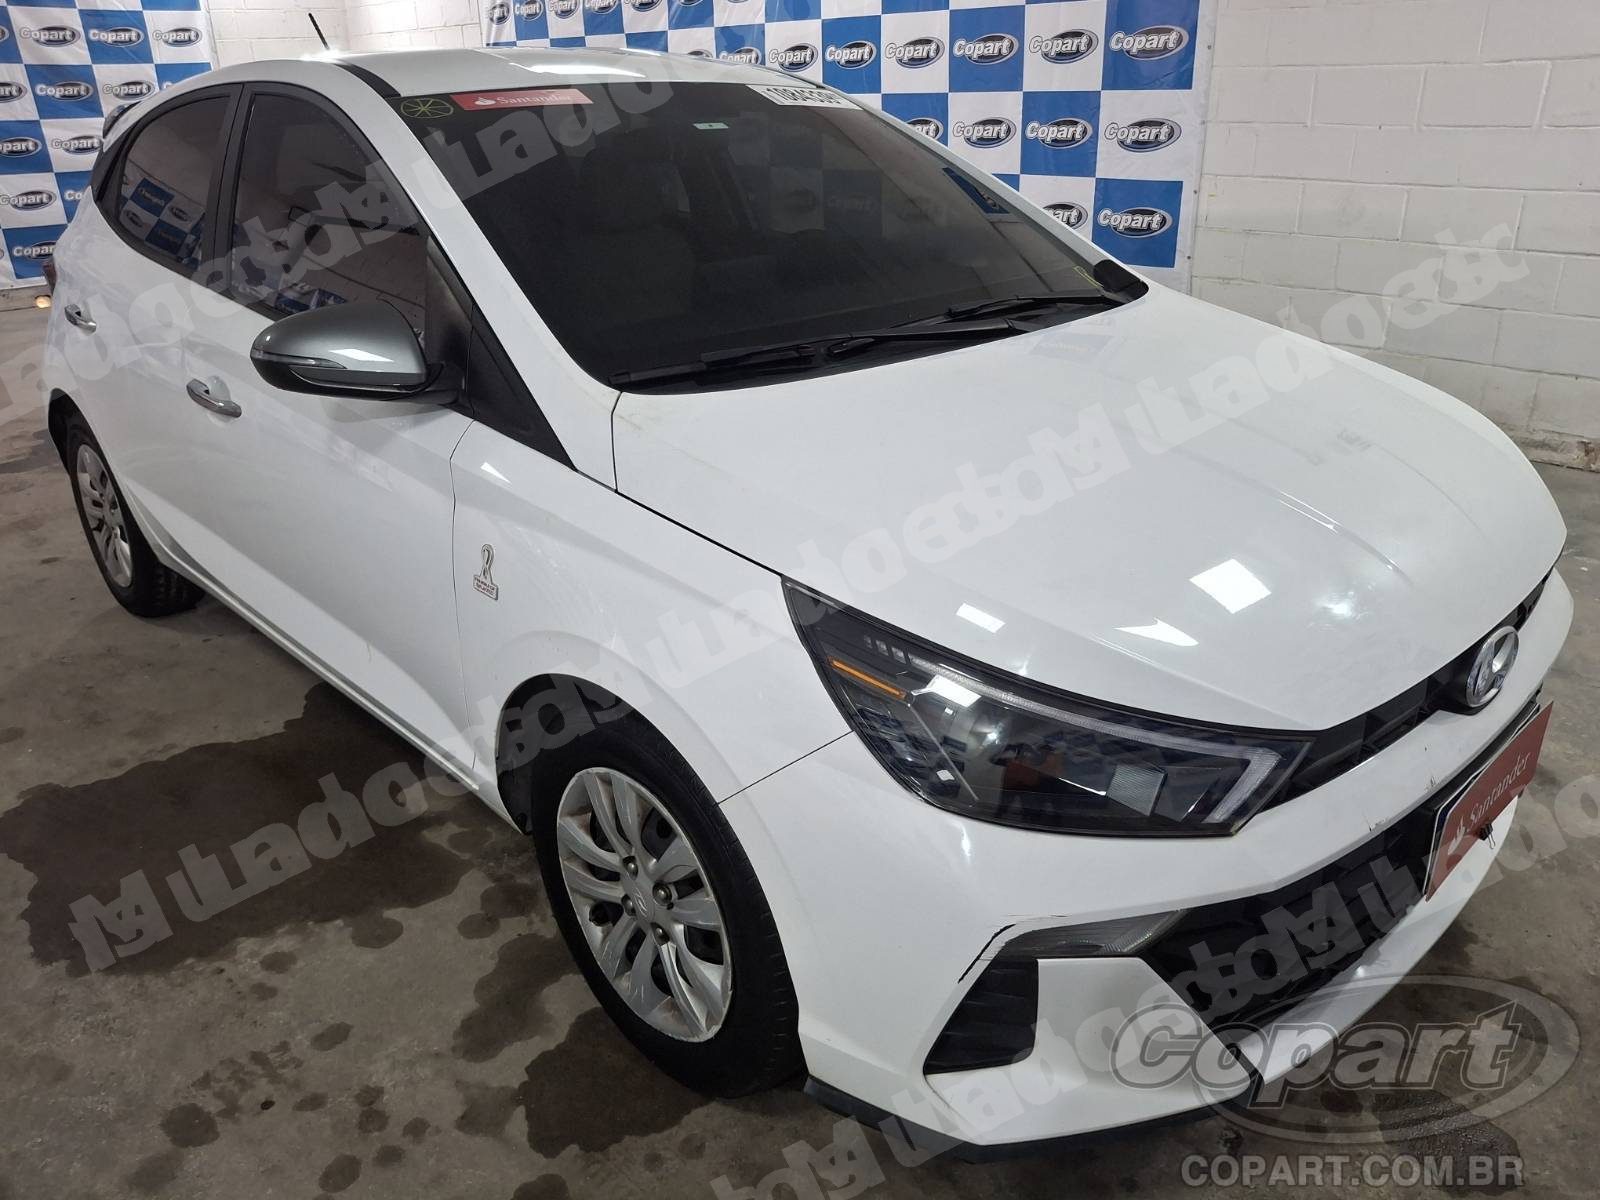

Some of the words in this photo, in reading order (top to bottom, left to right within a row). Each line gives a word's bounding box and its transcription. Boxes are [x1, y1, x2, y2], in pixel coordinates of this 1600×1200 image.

[21, 27, 73, 43] Copart
[89, 28, 138, 43] Copart
[153, 30, 196, 42] Copart
[1110, 30, 1182, 54] Copart
[825, 44, 871, 64] Copart
[885, 42, 938, 63] Copart
[953, 36, 1014, 60] Copart
[1029, 34, 1088, 57] Copart
[769, 48, 812, 65] Copart
[36, 83, 87, 99] Copart
[103, 83, 148, 97] Copart
[953, 120, 1008, 142] Copart
[1026, 120, 1084, 143] Copart
[1105, 122, 1170, 146] Copart
[52, 136, 100, 152] Copart
[1099, 208, 1164, 232] Copart
[13, 245, 56, 258] Copar
[1470, 752, 1532, 825] Santander
